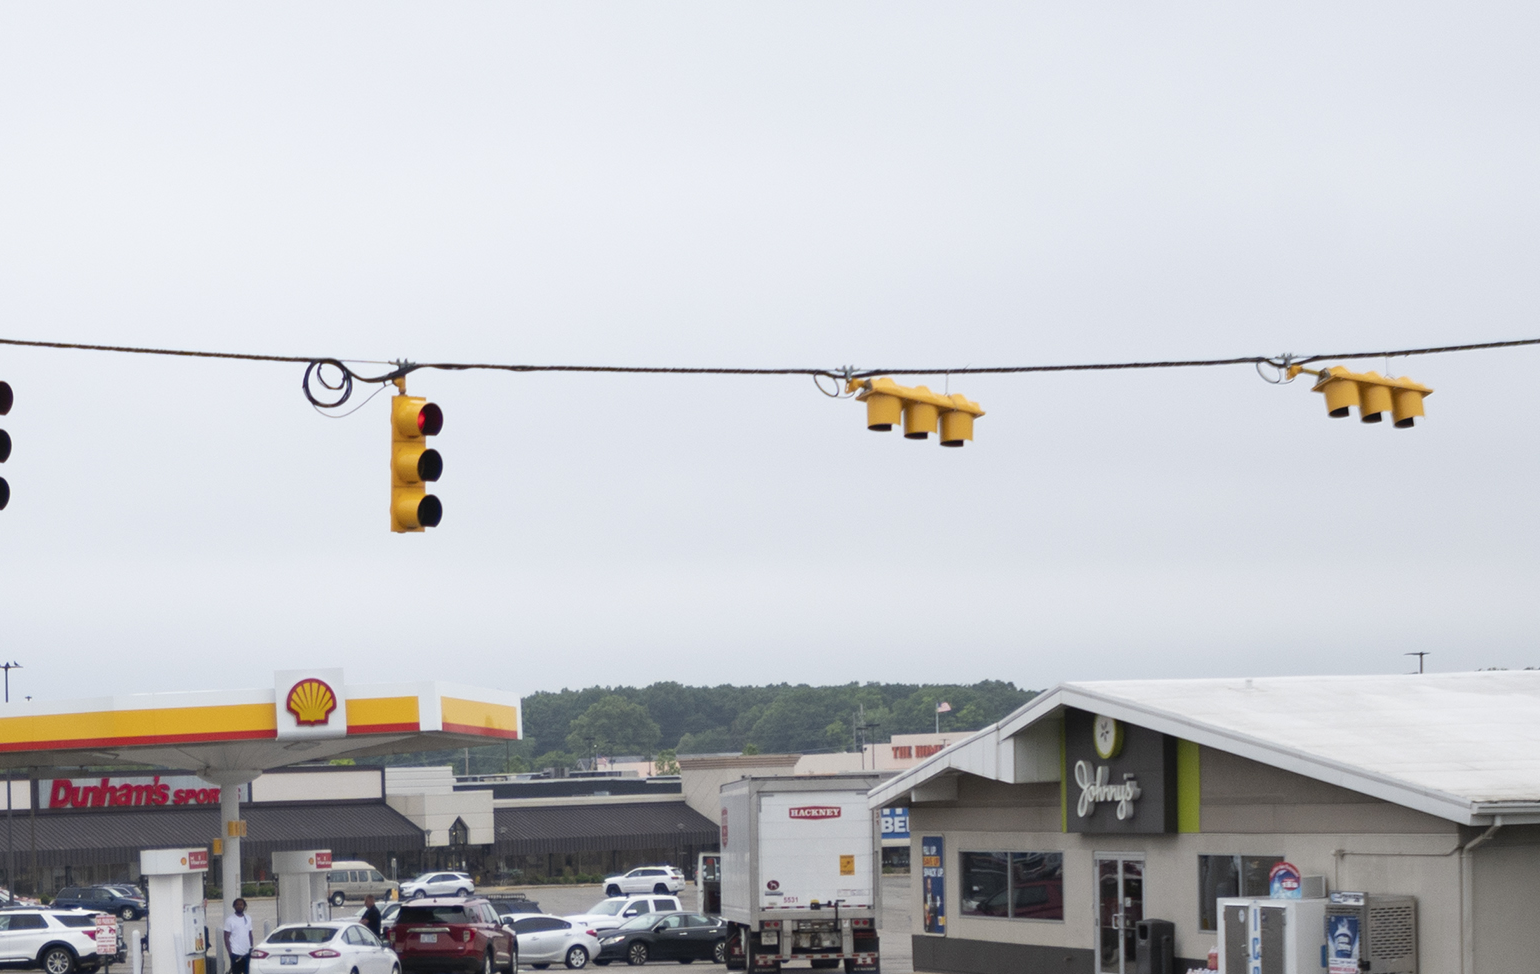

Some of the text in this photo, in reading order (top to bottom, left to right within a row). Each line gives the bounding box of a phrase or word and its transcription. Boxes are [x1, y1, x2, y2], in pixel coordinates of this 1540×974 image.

[892, 745, 912, 759] THE
[49, 775, 170, 809] Dunham's
[790, 808, 840, 817] HACKNEY
[783, 896, 799, 904] 5531
